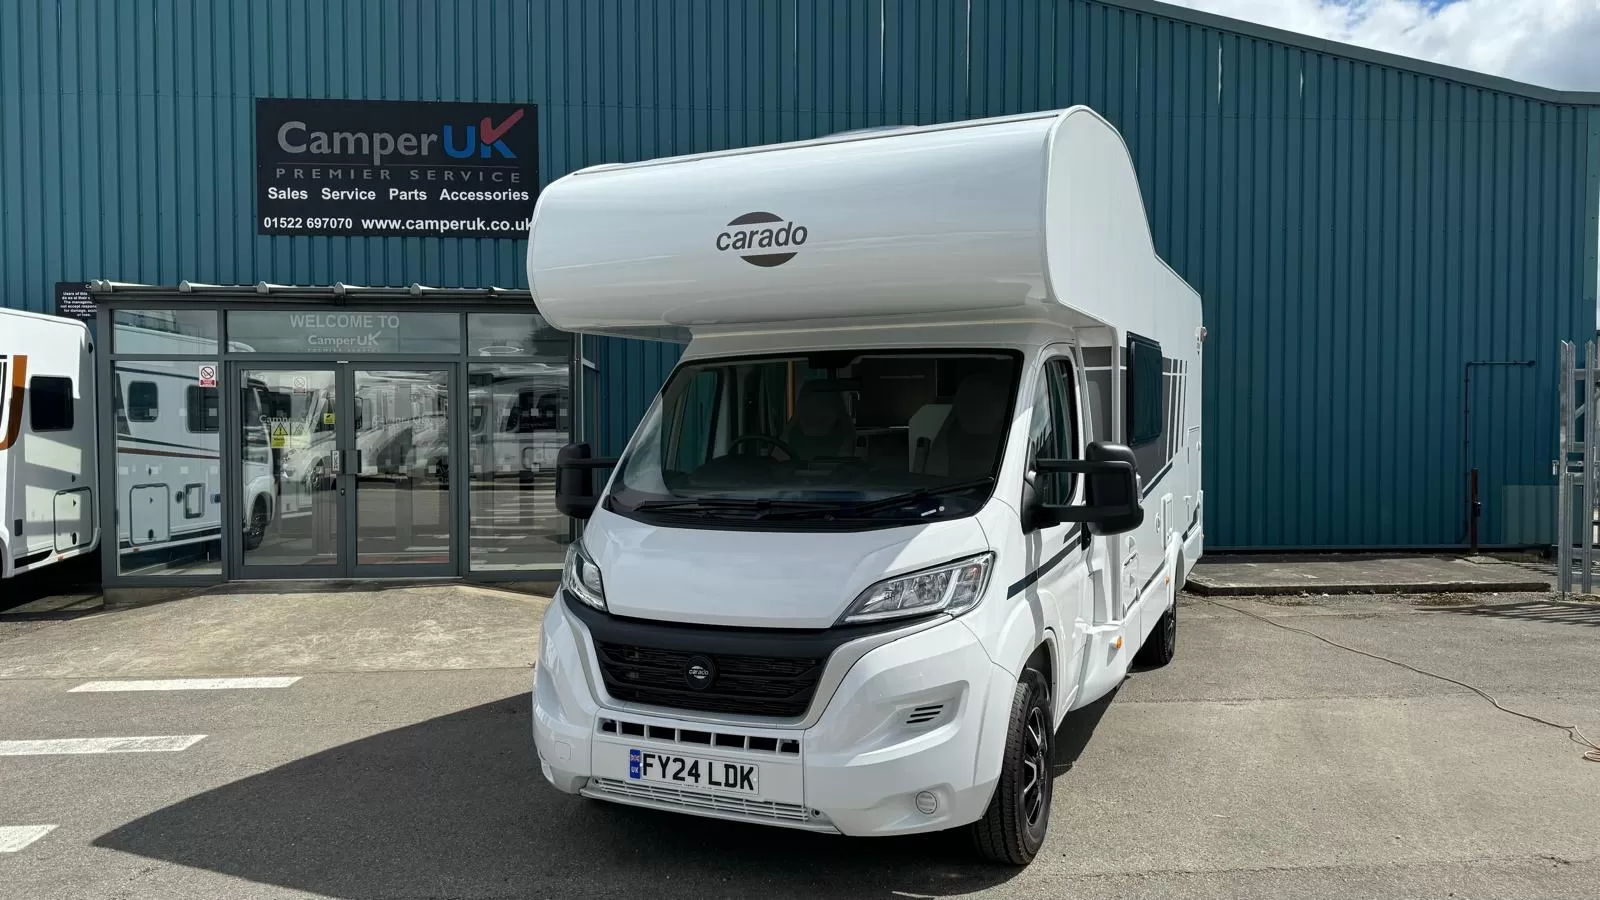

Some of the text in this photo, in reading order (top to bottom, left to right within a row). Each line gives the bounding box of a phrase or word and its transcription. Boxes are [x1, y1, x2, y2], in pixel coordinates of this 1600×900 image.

[277, 108, 525, 166] CamperUK
[276, 168, 521, 183] PREMIER SERVICE
[267, 187, 530, 201] Sales Service Parts Accessories
[263, 217, 532, 233] 01522 697070 www.camperuk.co.uk
[716, 221, 808, 251] carado
[289, 314, 400, 329] WELCOME TO
[307, 330, 382, 348] CamperUK
[630, 766, 639, 774] UK
[642, 753, 754, 791] FY24 LDK
